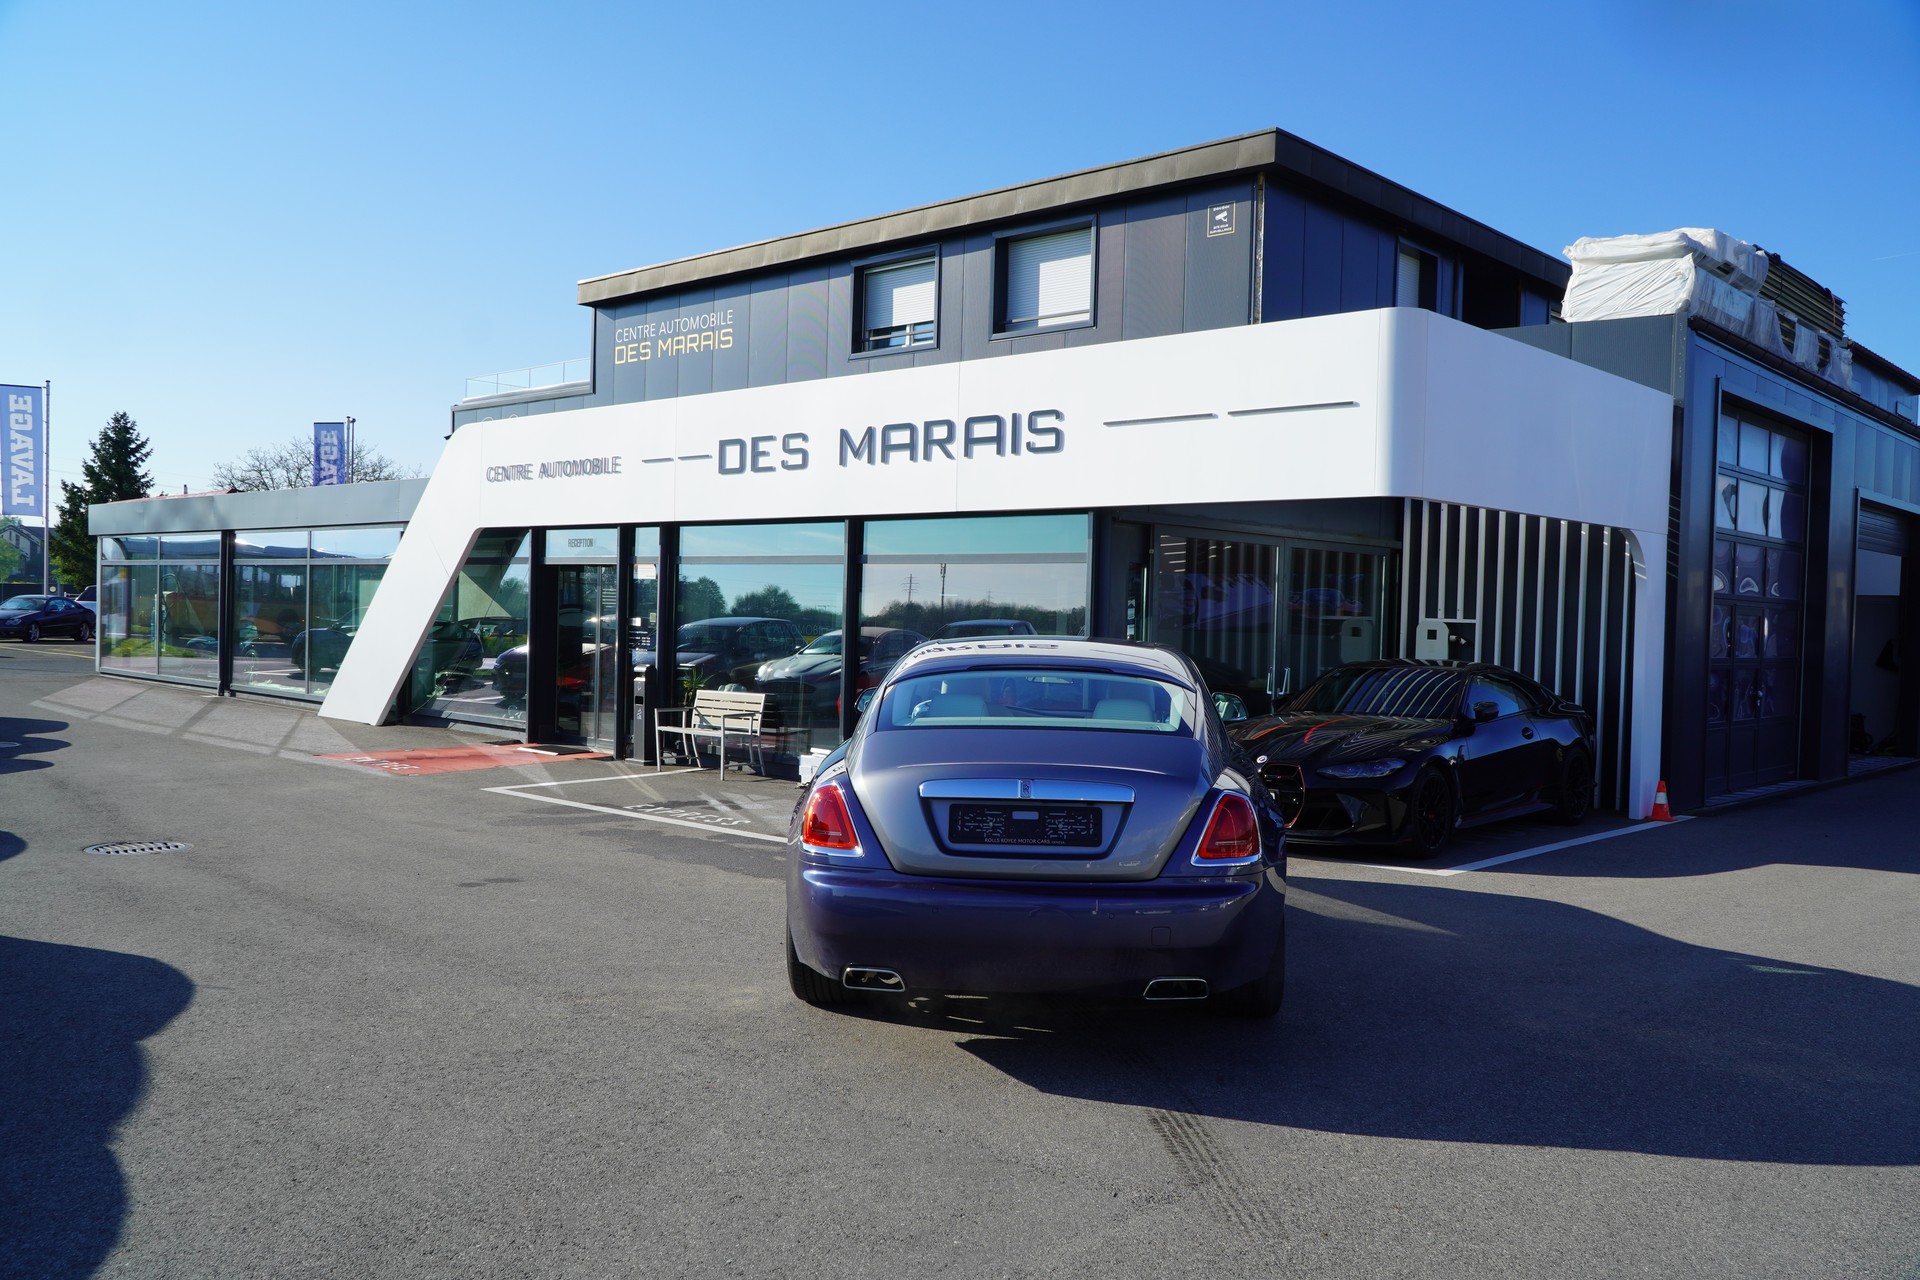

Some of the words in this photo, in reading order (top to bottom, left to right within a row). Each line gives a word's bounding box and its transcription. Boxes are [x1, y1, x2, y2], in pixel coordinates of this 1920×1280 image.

[615, 323, 656, 343] CENTRE
[658, 309, 733, 336] AUTOMOBILE
[614, 341, 651, 365] DES
[657, 328, 733, 358] MARAIS
[486, 463, 534, 483] CENTRE
[538, 456, 622, 479] AUTOMOBILE
[718, 432, 809, 475] DES
[838, 409, 1066, 467] MARAIS
[622, 803, 751, 826] EXPRESS
